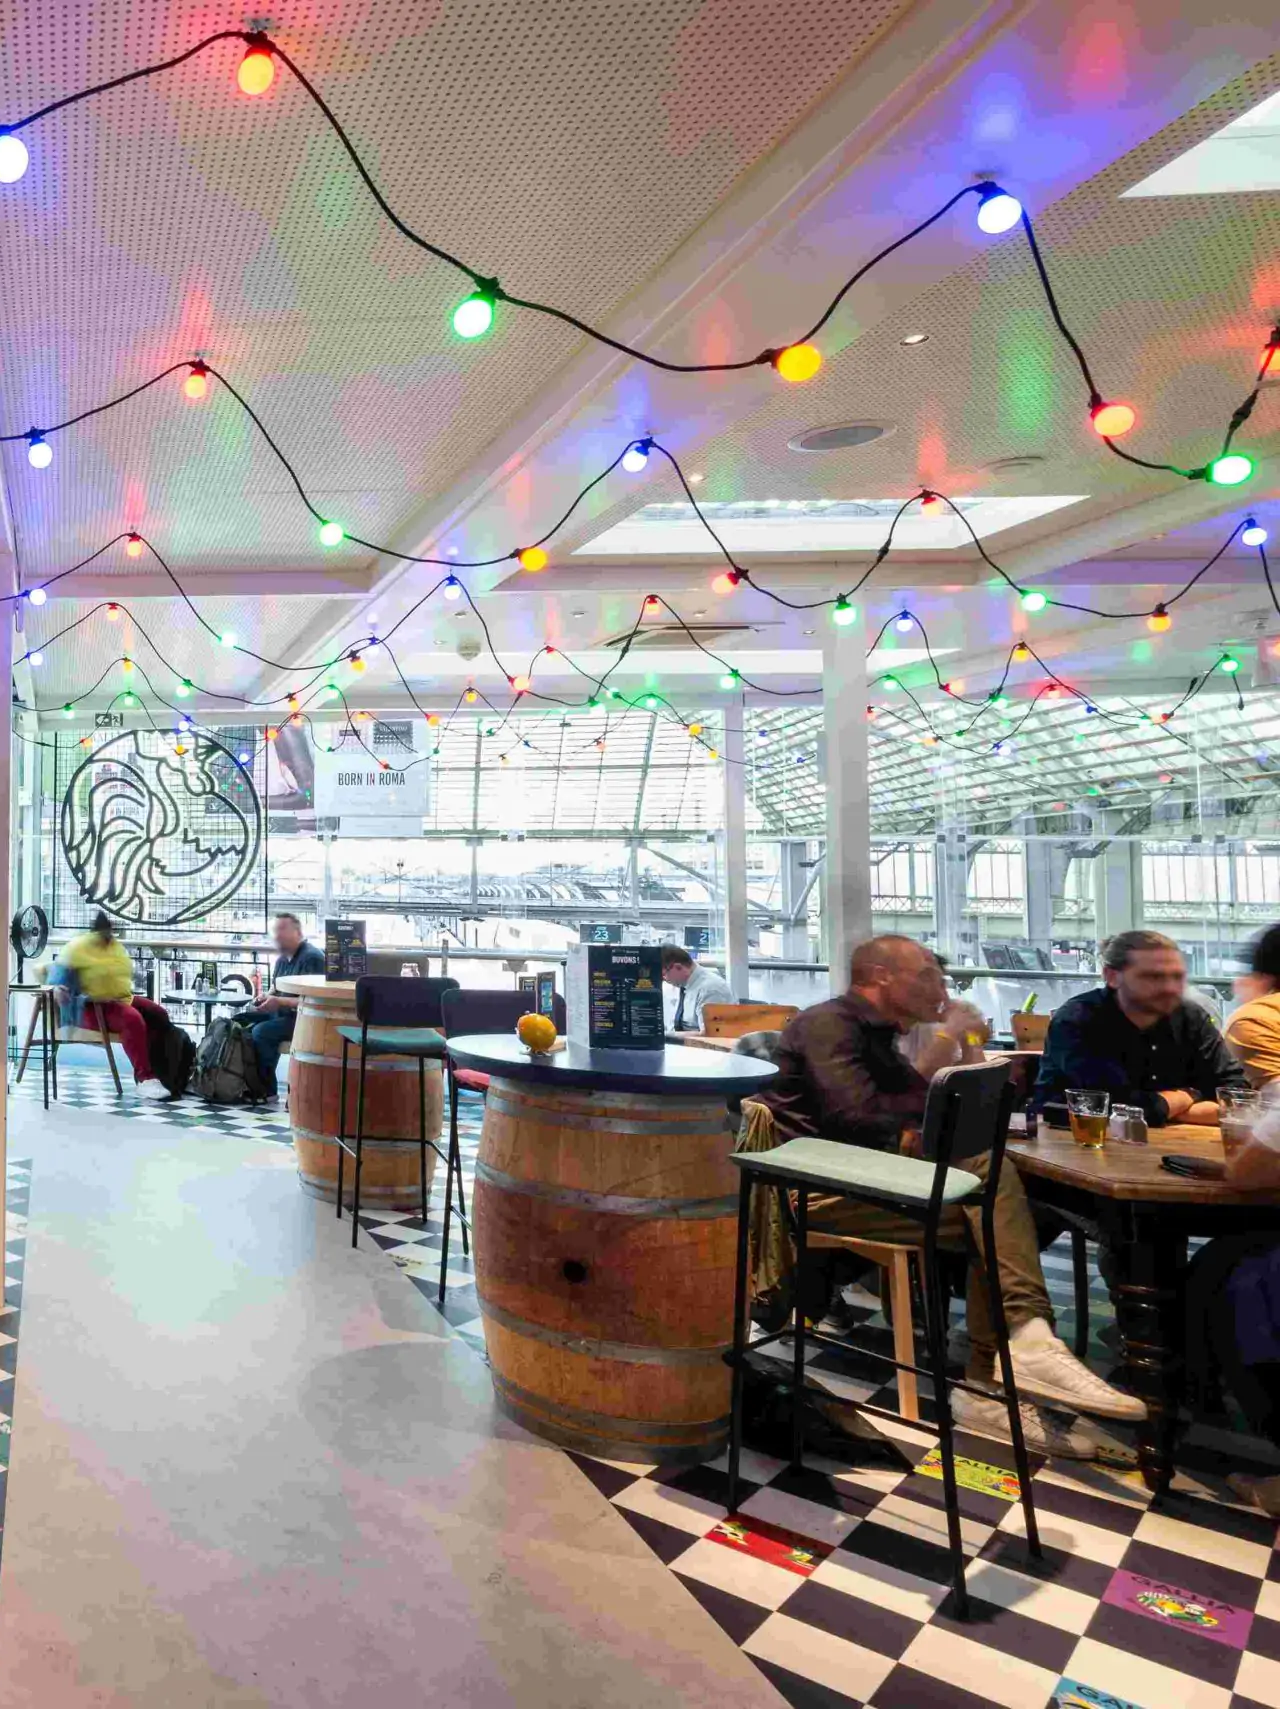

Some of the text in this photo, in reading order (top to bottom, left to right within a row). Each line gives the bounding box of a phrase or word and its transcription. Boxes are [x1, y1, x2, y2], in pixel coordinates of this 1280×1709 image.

[338, 772, 406, 786] BORN IN ROMA
[594, 930, 609, 940] 23
[1131, 1575, 1236, 1615] GALLIA
